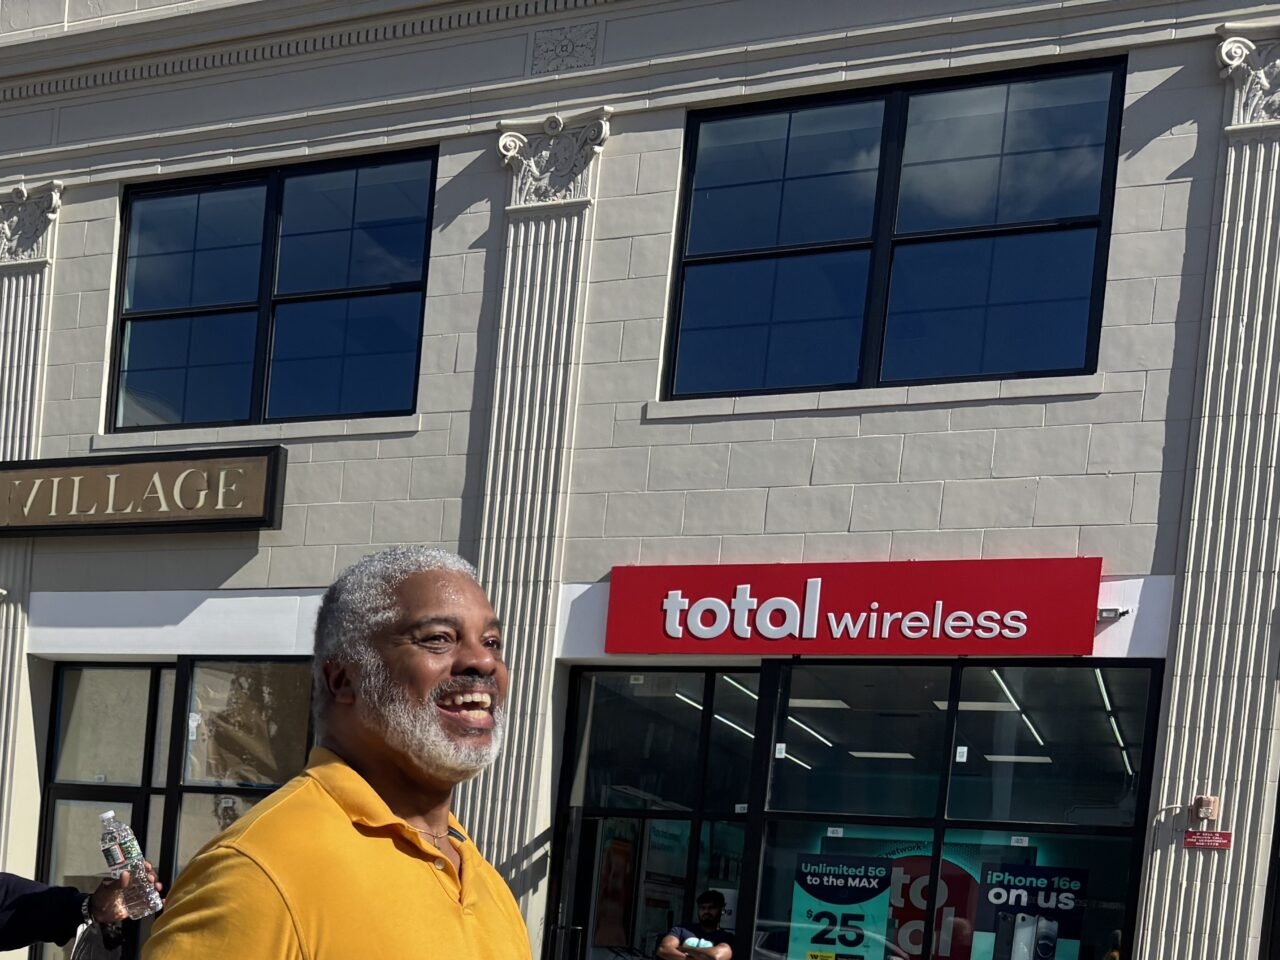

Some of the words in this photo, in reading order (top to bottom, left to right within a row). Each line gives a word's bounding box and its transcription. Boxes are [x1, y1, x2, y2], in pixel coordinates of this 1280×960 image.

[15, 467, 245, 518] VILLAGE
[663, 577, 822, 640] total
[827, 600, 1028, 640] wireless
[801, 863, 865, 876] Unlimited
[867, 867, 886, 877] 5G
[987, 870, 1048, 888] iPhone
[1051, 876, 1082, 891] 16e
[806, 874, 820, 885] to
[823, 875, 845, 887] the
[847, 877, 879, 889] MAX
[987, 887, 1028, 907] on
[1037, 891, 1076, 910] us
